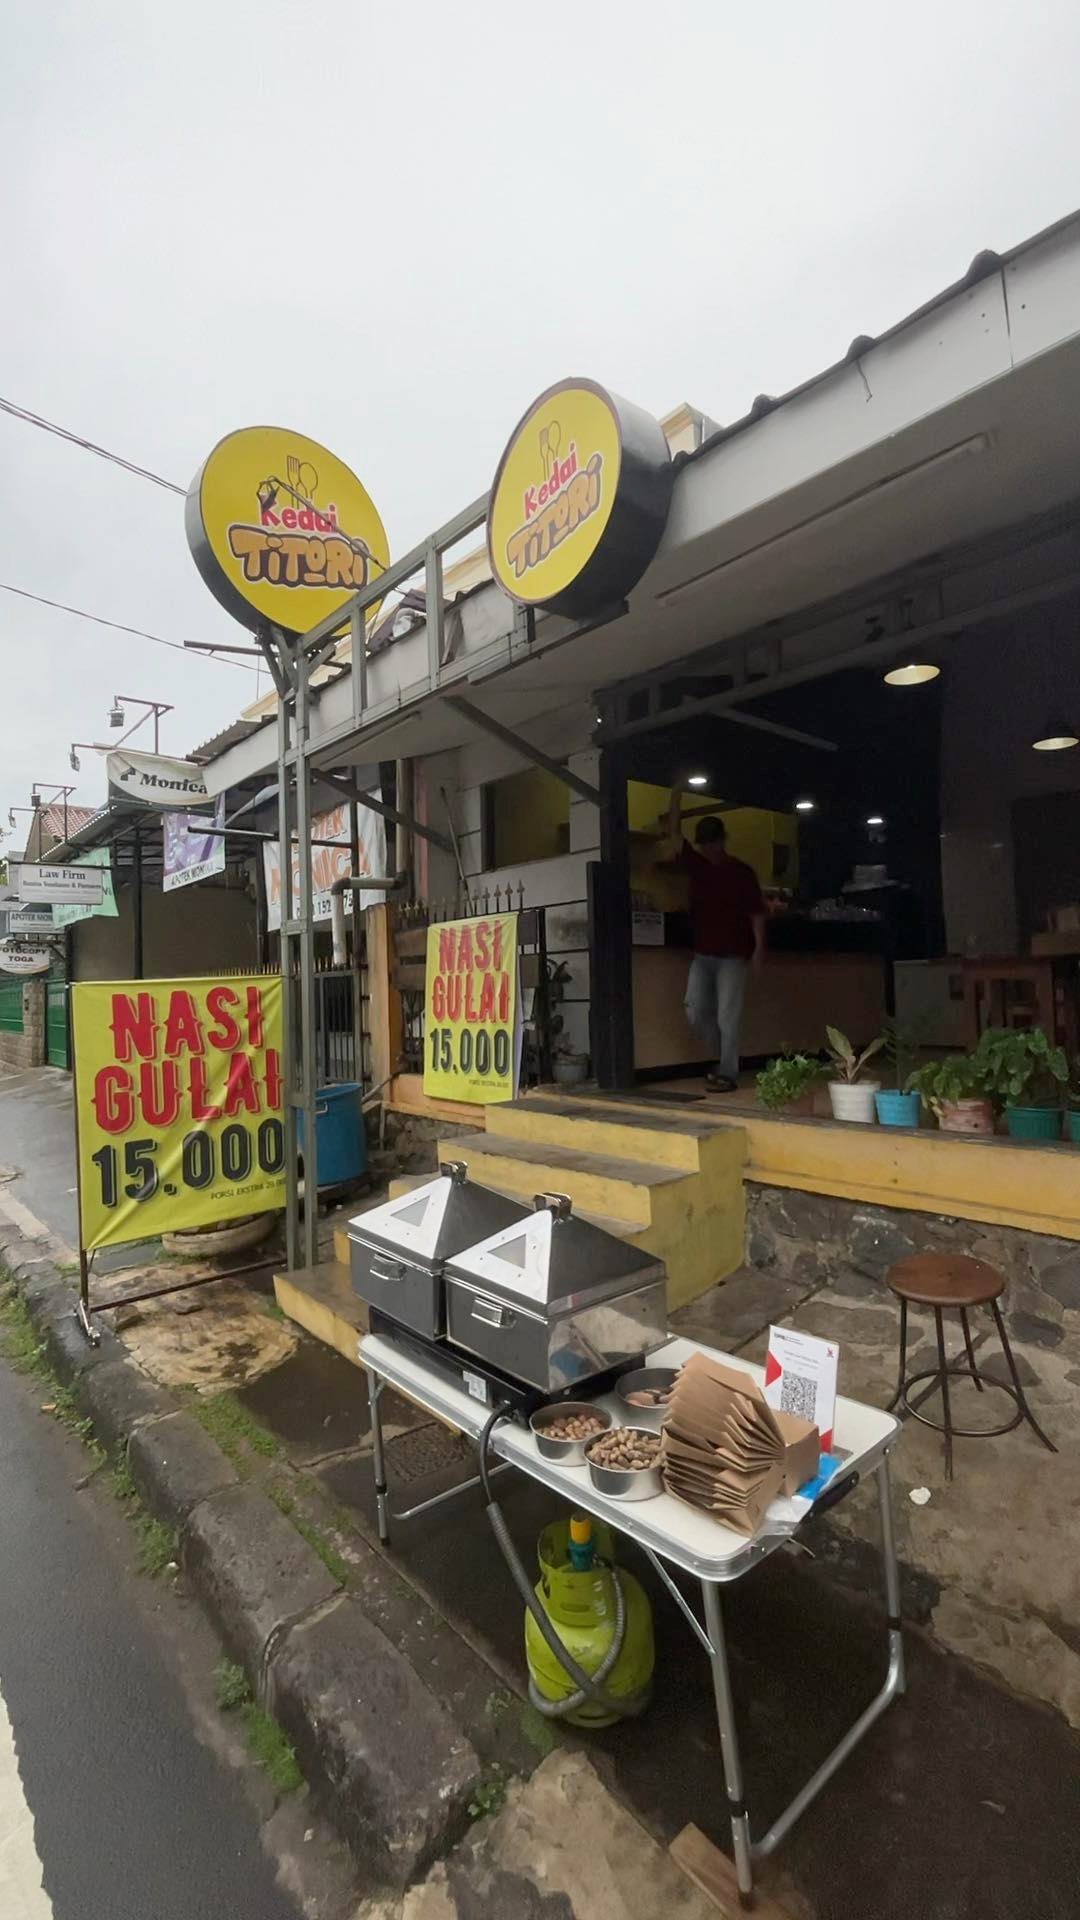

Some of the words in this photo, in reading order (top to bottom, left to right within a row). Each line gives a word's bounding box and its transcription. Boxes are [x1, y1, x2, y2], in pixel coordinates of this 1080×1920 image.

[525, 441, 577, 521] Kedai
[260, 492, 338, 533] Kedai
[140, 773, 208, 795] Monica
[39, 868, 59, 879] Law
[62, 869, 86, 880] Firm
[0, 945, 48, 954] OTOCOPY
[439, 919, 503, 974] NASI
[109, 986, 265, 1062] NASI
[432, 970, 510, 1024] GULAI
[91, 1048, 284, 1134] GULAI
[91, 1117, 287, 1207] 15.000
